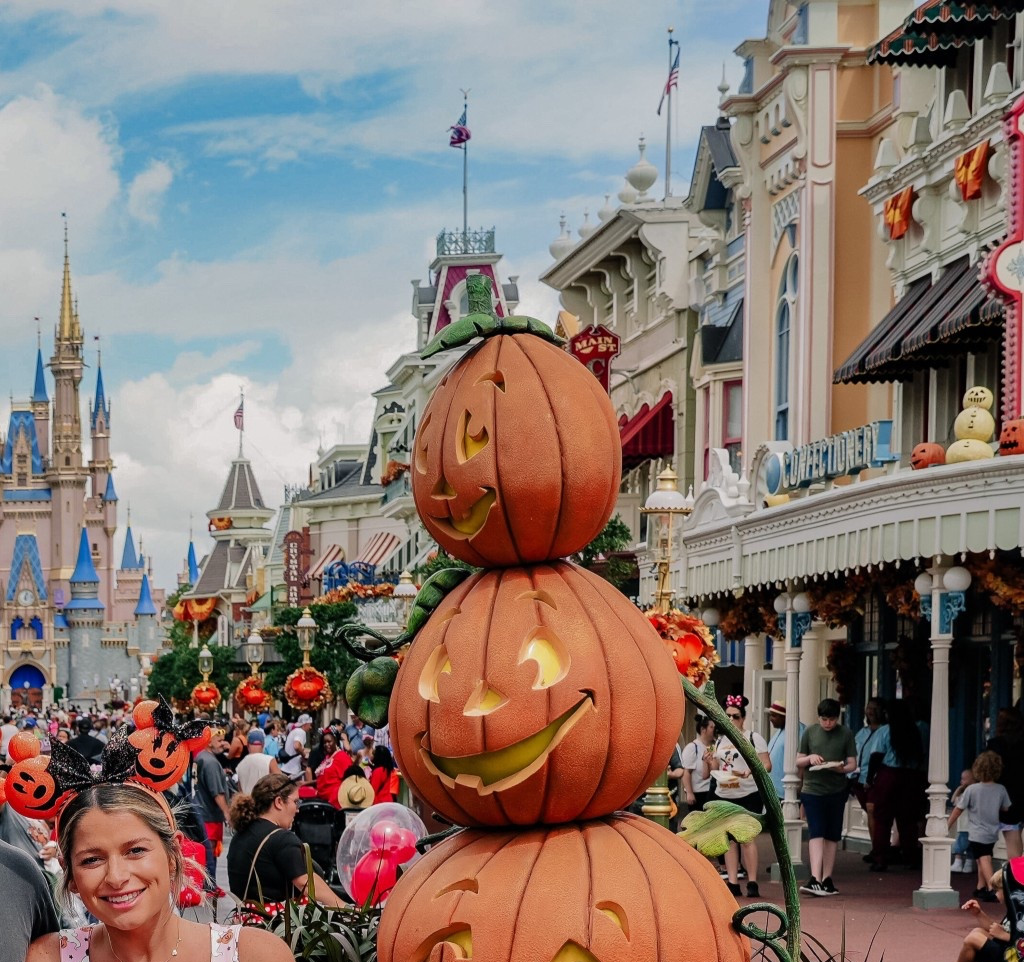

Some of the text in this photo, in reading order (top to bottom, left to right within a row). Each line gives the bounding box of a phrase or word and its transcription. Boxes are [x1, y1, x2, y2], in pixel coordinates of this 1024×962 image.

[574, 336, 613, 351] MAIN
[597, 343, 617, 352] ST.
[782, 421, 880, 488] CONFECTIONERY
